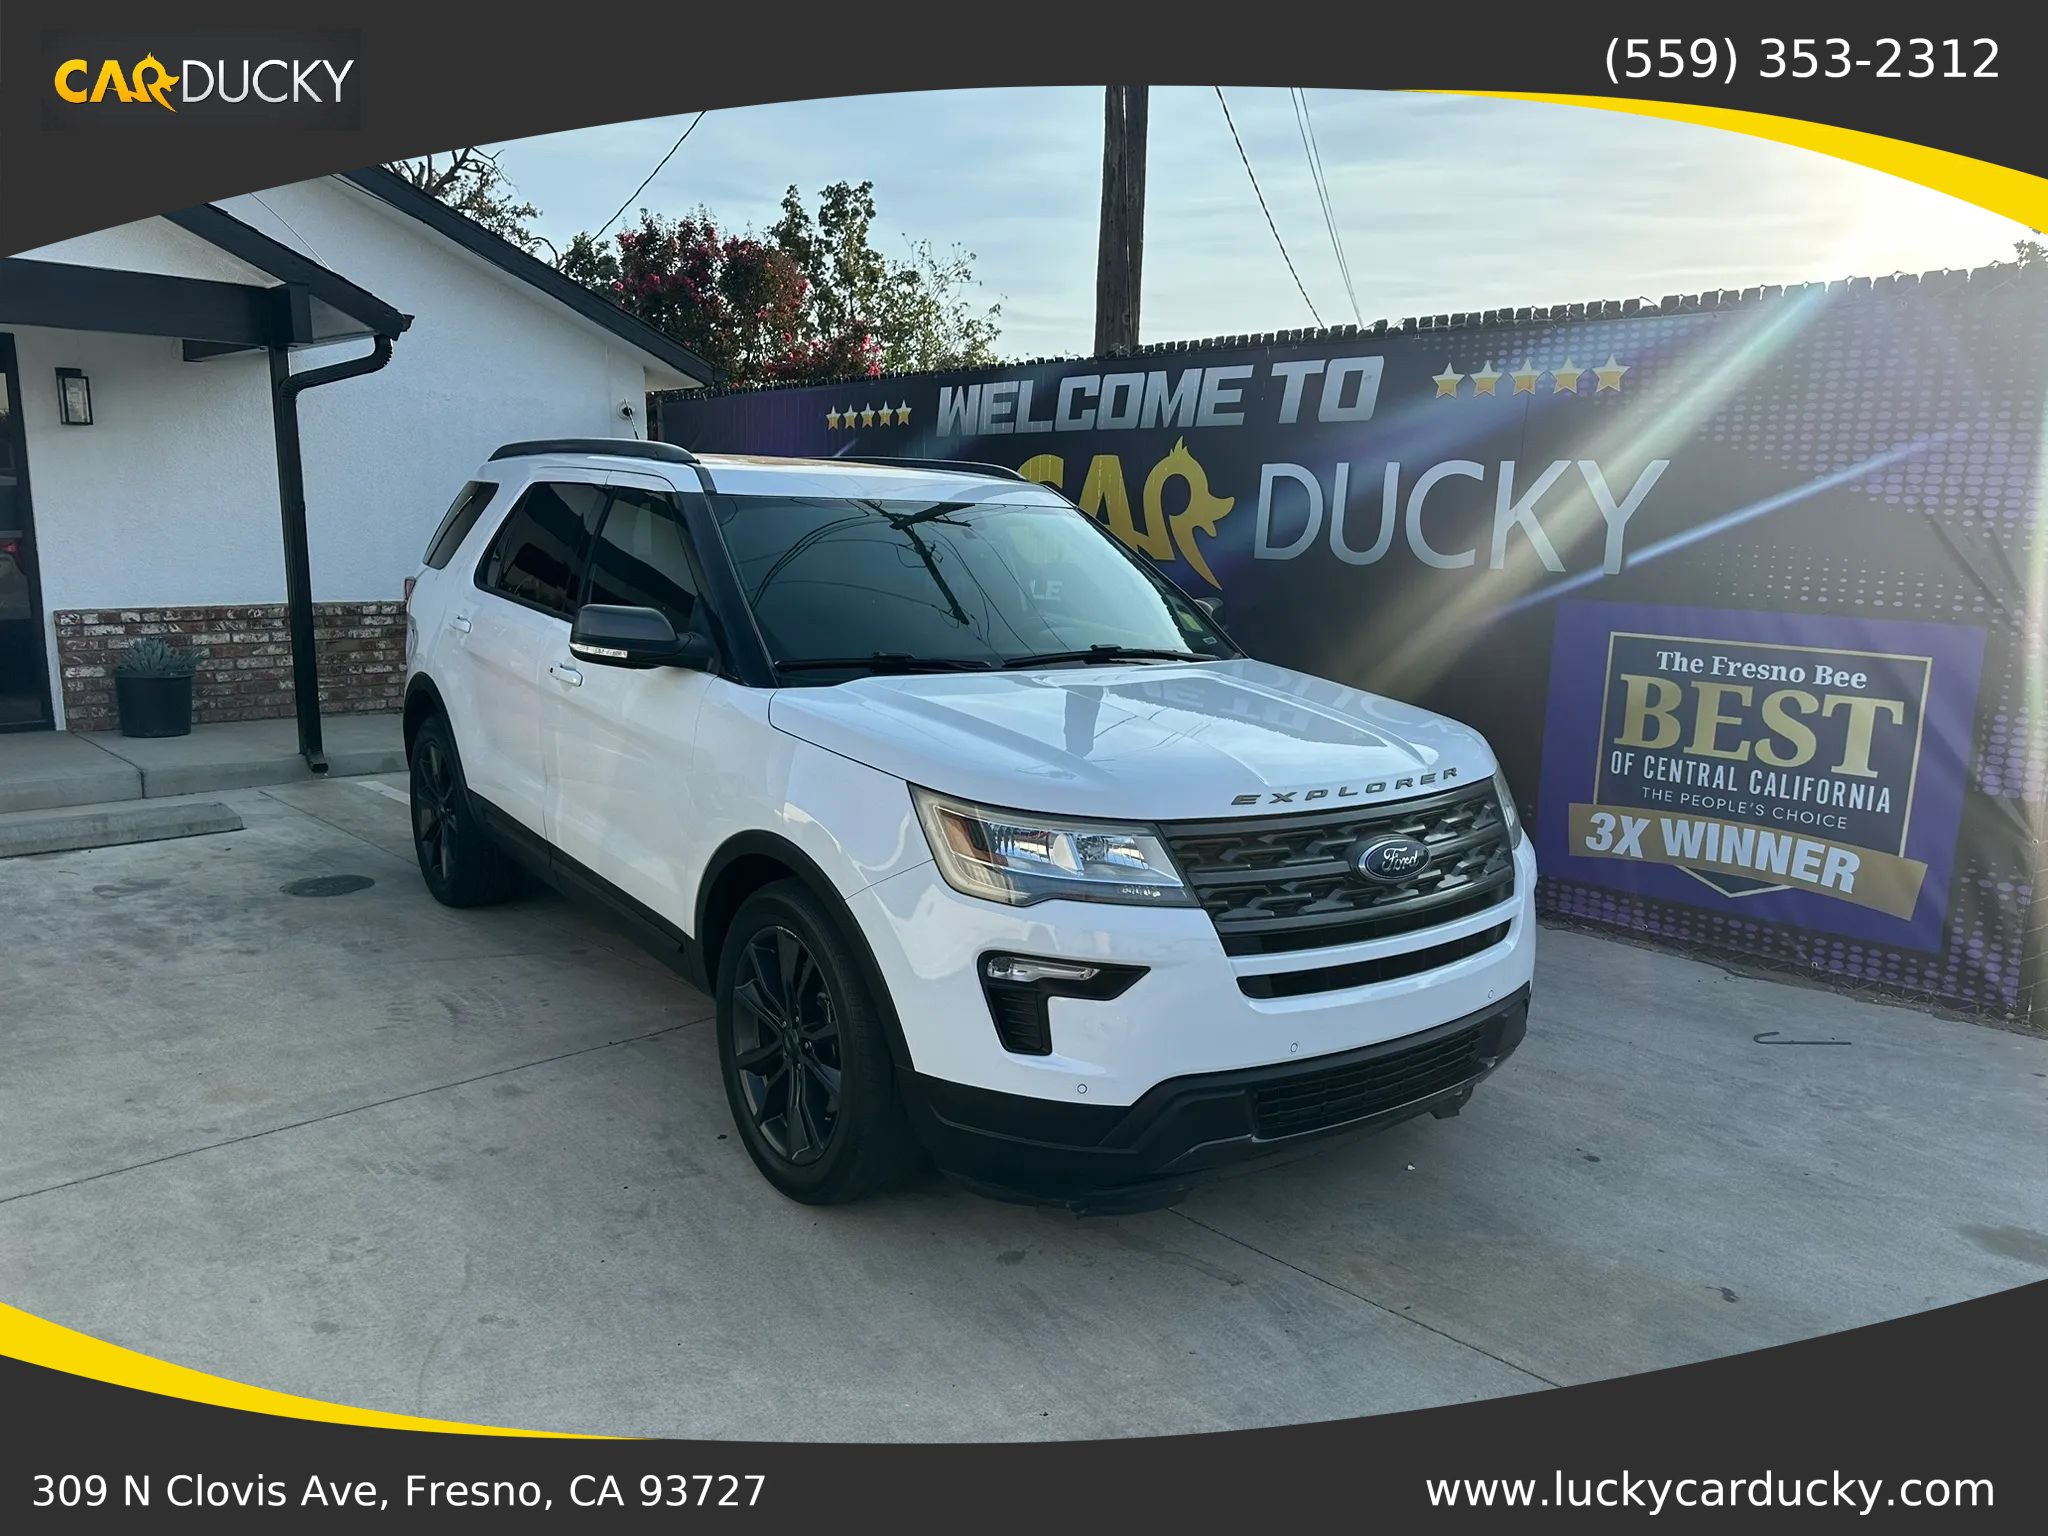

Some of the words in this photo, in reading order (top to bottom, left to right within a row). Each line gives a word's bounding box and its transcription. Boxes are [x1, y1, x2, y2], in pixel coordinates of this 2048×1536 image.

[936, 364, 1253, 437] WELCOME
[1271, 355, 1385, 424] TO
[1253, 459, 1670, 575] DUCKY
[1656, 651, 1704, 674] The
[1709, 656, 1806, 683] Fresno
[1812, 665, 1868, 689] Bee
[1613, 673, 1905, 779] BEST
[1231, 767, 1458, 806] EXPLORER
[1610, 750, 1635, 776] OF
[1643, 755, 1738, 793] CENTRAL
[1749, 769, 1891, 814] CALIFORNIA
[1642, 786, 1673, 803] THE
[1680, 793, 1765, 817] PEOPLE'S
[1772, 806, 1848, 830] CHOICE
[1381, 847, 1419, 872] Ford
[1585, 812, 1651, 859] 3X
[1660, 817, 1861, 894] WINNER
